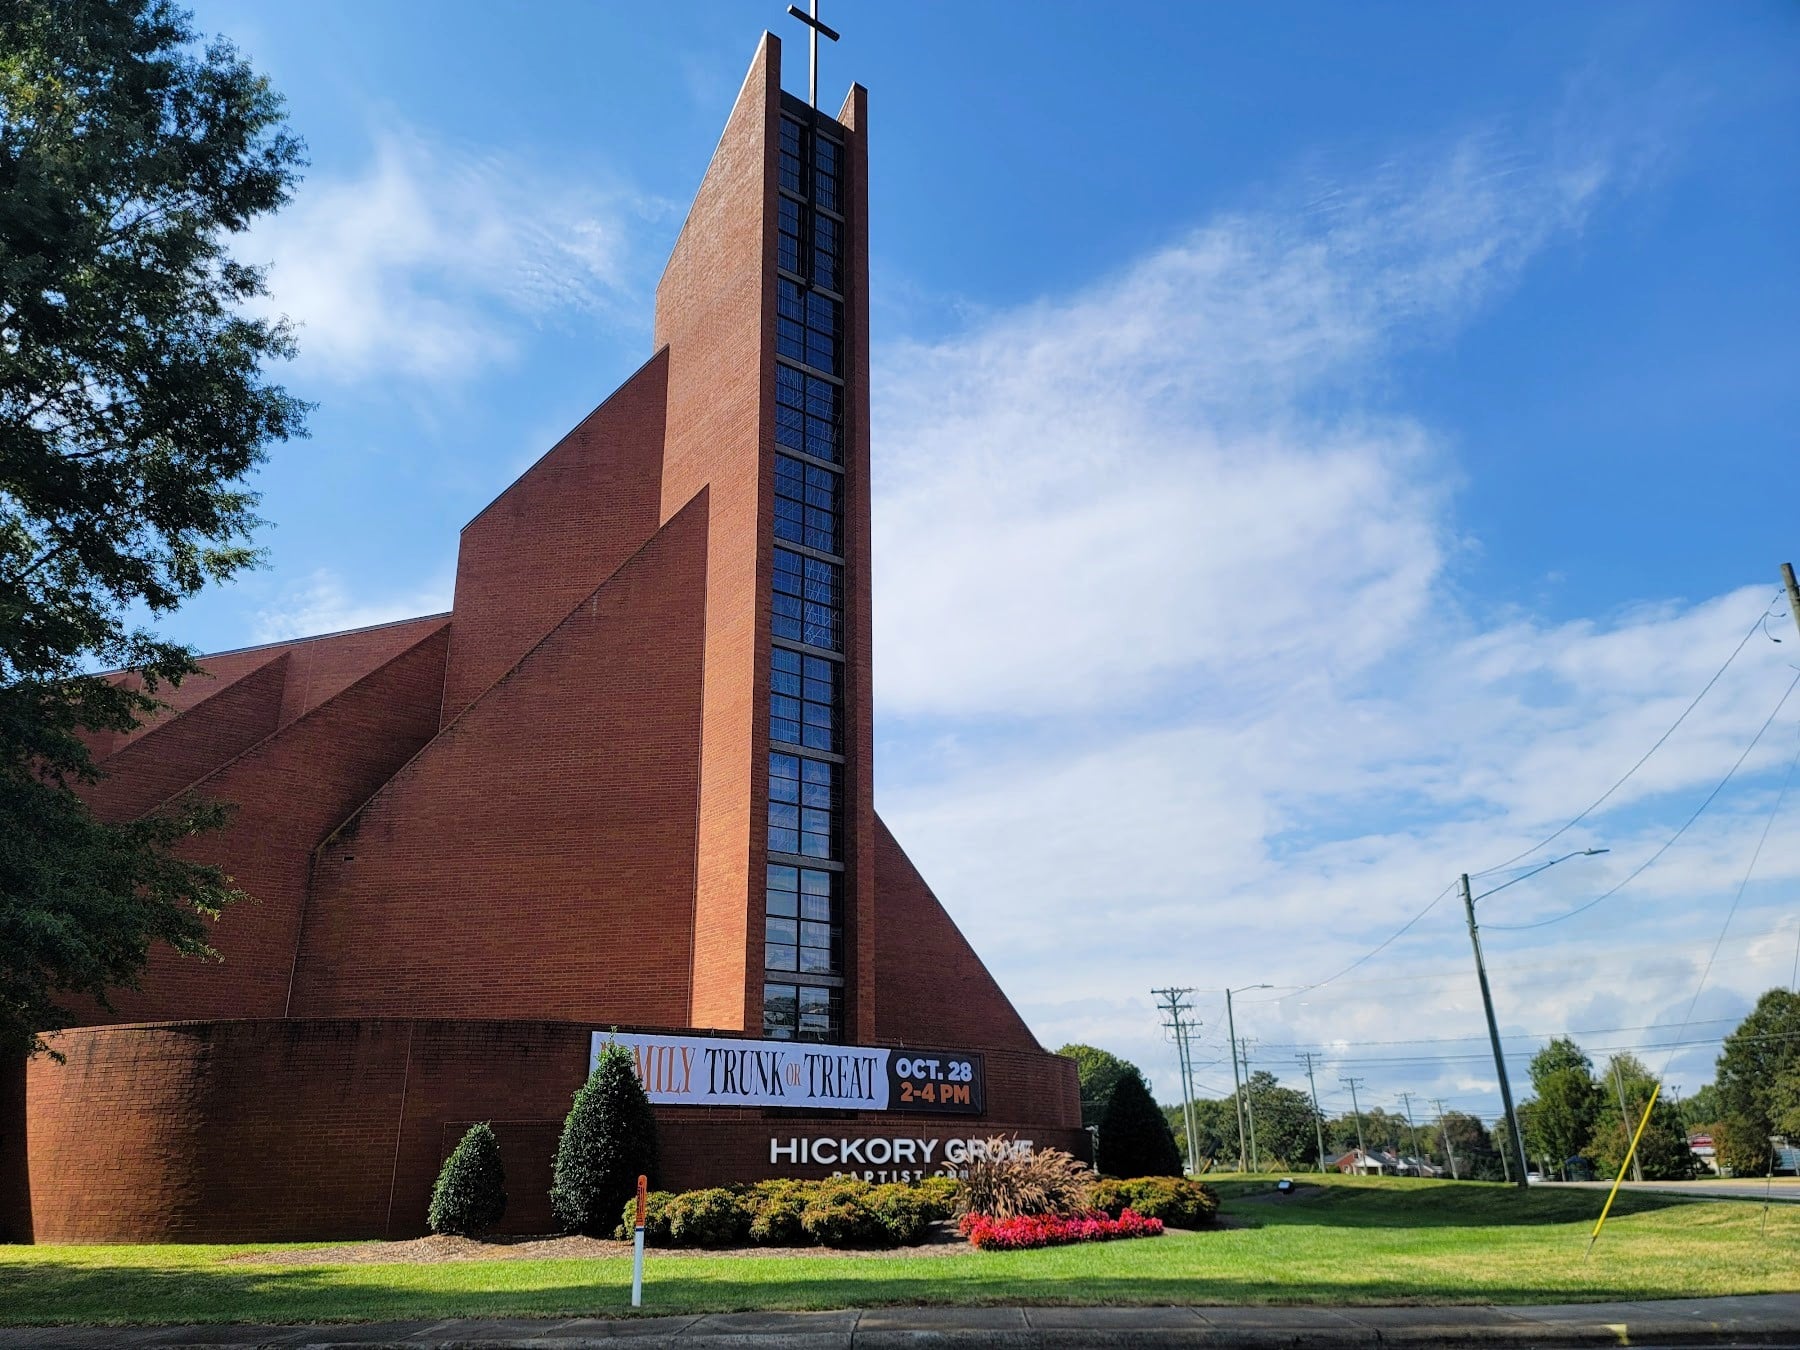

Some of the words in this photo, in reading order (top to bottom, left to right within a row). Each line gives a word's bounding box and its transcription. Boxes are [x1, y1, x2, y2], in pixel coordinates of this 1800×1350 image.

[600, 1041, 696, 1096] MILY
[703, 1048, 786, 1096] TRUNK
[786, 1062, 801, 1087] OR
[803, 1053, 878, 1100] TREAT
[895, 1057, 944, 1080] OCT.
[948, 1061, 973, 1082] 28
[900, 1081, 936, 1103] 2-4
[940, 1083, 970, 1105] PM
[770, 1137, 939, 1165] HICKORY
[832, 1170, 923, 1184] BAPTIST
